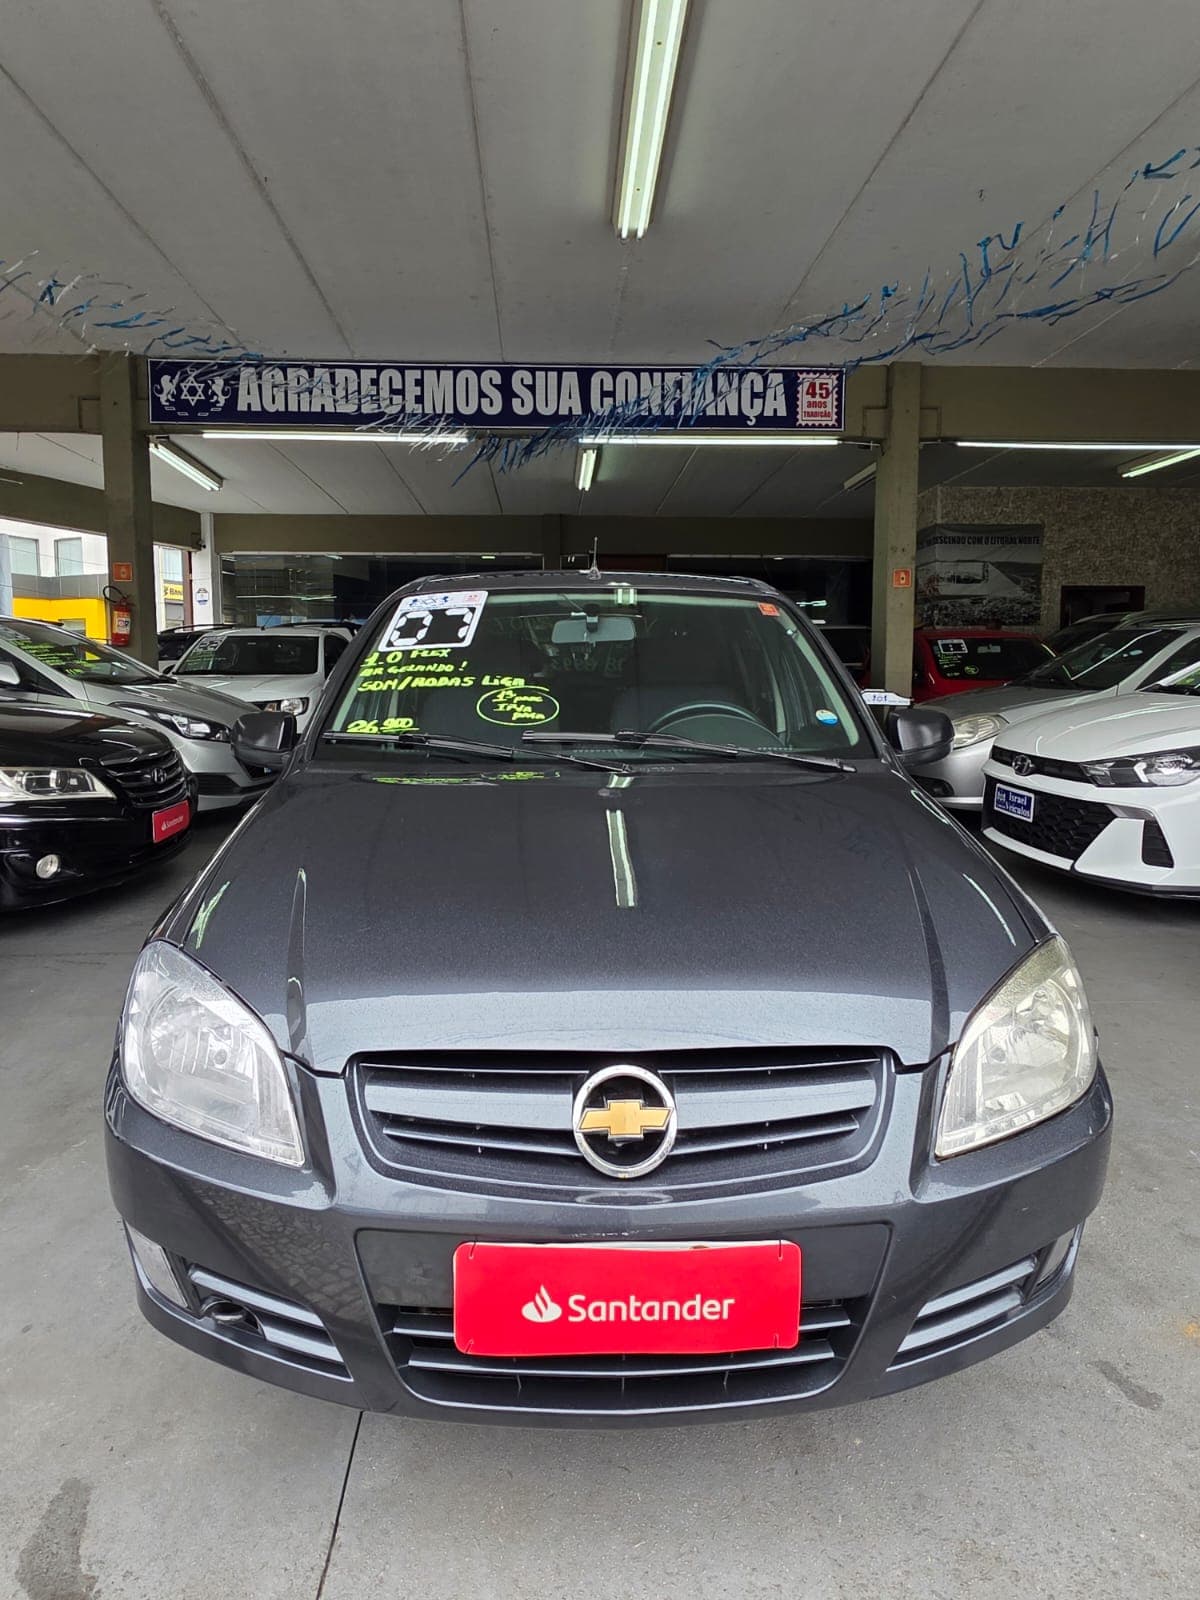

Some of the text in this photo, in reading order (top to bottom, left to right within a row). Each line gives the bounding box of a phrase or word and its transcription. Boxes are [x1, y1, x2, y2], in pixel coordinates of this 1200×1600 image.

[236, 366, 788, 426] AGRADECEMOS SUA CONFIANÇA
[805, 381, 831, 400] 45
[806, 400, 828, 409] anos
[389, 607, 473, 647] 07
[410, 648, 452, 659] FLEX
[1009, 791, 1027, 806] Israel
[568, 1294, 735, 1322] Santander
